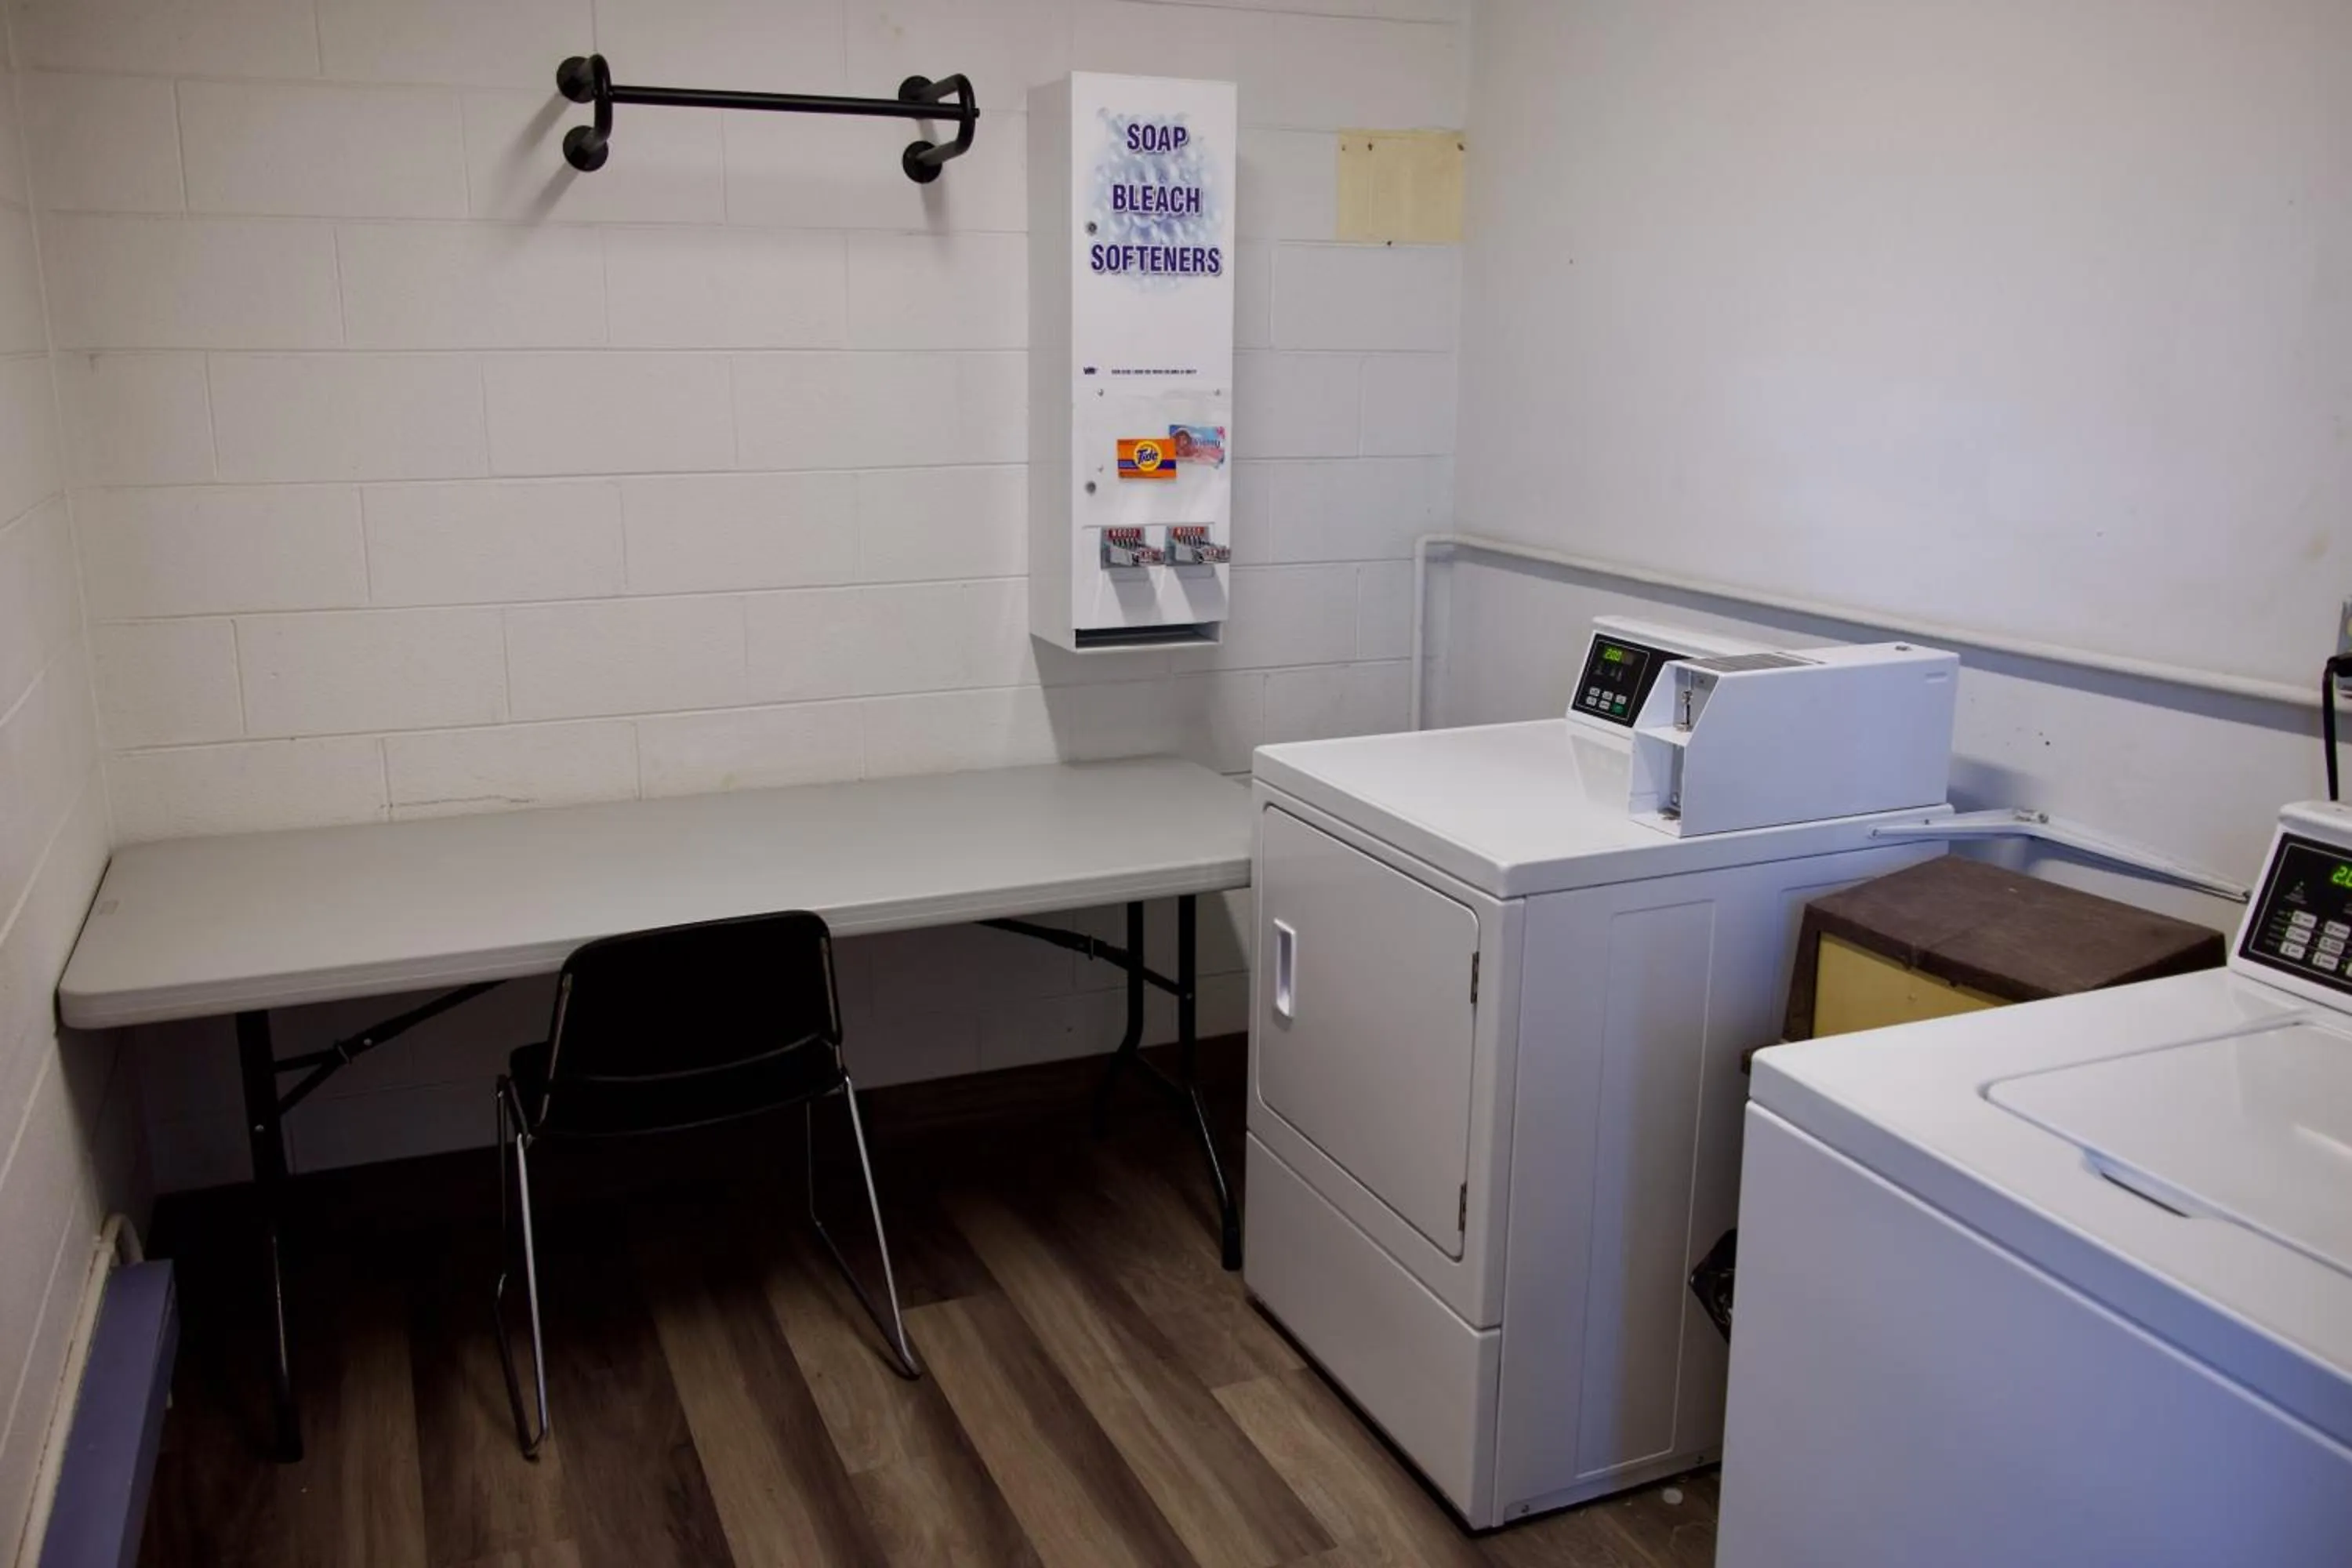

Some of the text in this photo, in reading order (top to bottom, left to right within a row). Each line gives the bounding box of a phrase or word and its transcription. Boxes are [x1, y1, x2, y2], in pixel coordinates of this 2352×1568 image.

[1127, 123, 1188, 151] SOAP
[1112, 184, 1201, 213] BLEACH
[1091, 245, 1221, 274] SOFTENERS
[1136, 448, 1158, 464] Tide
